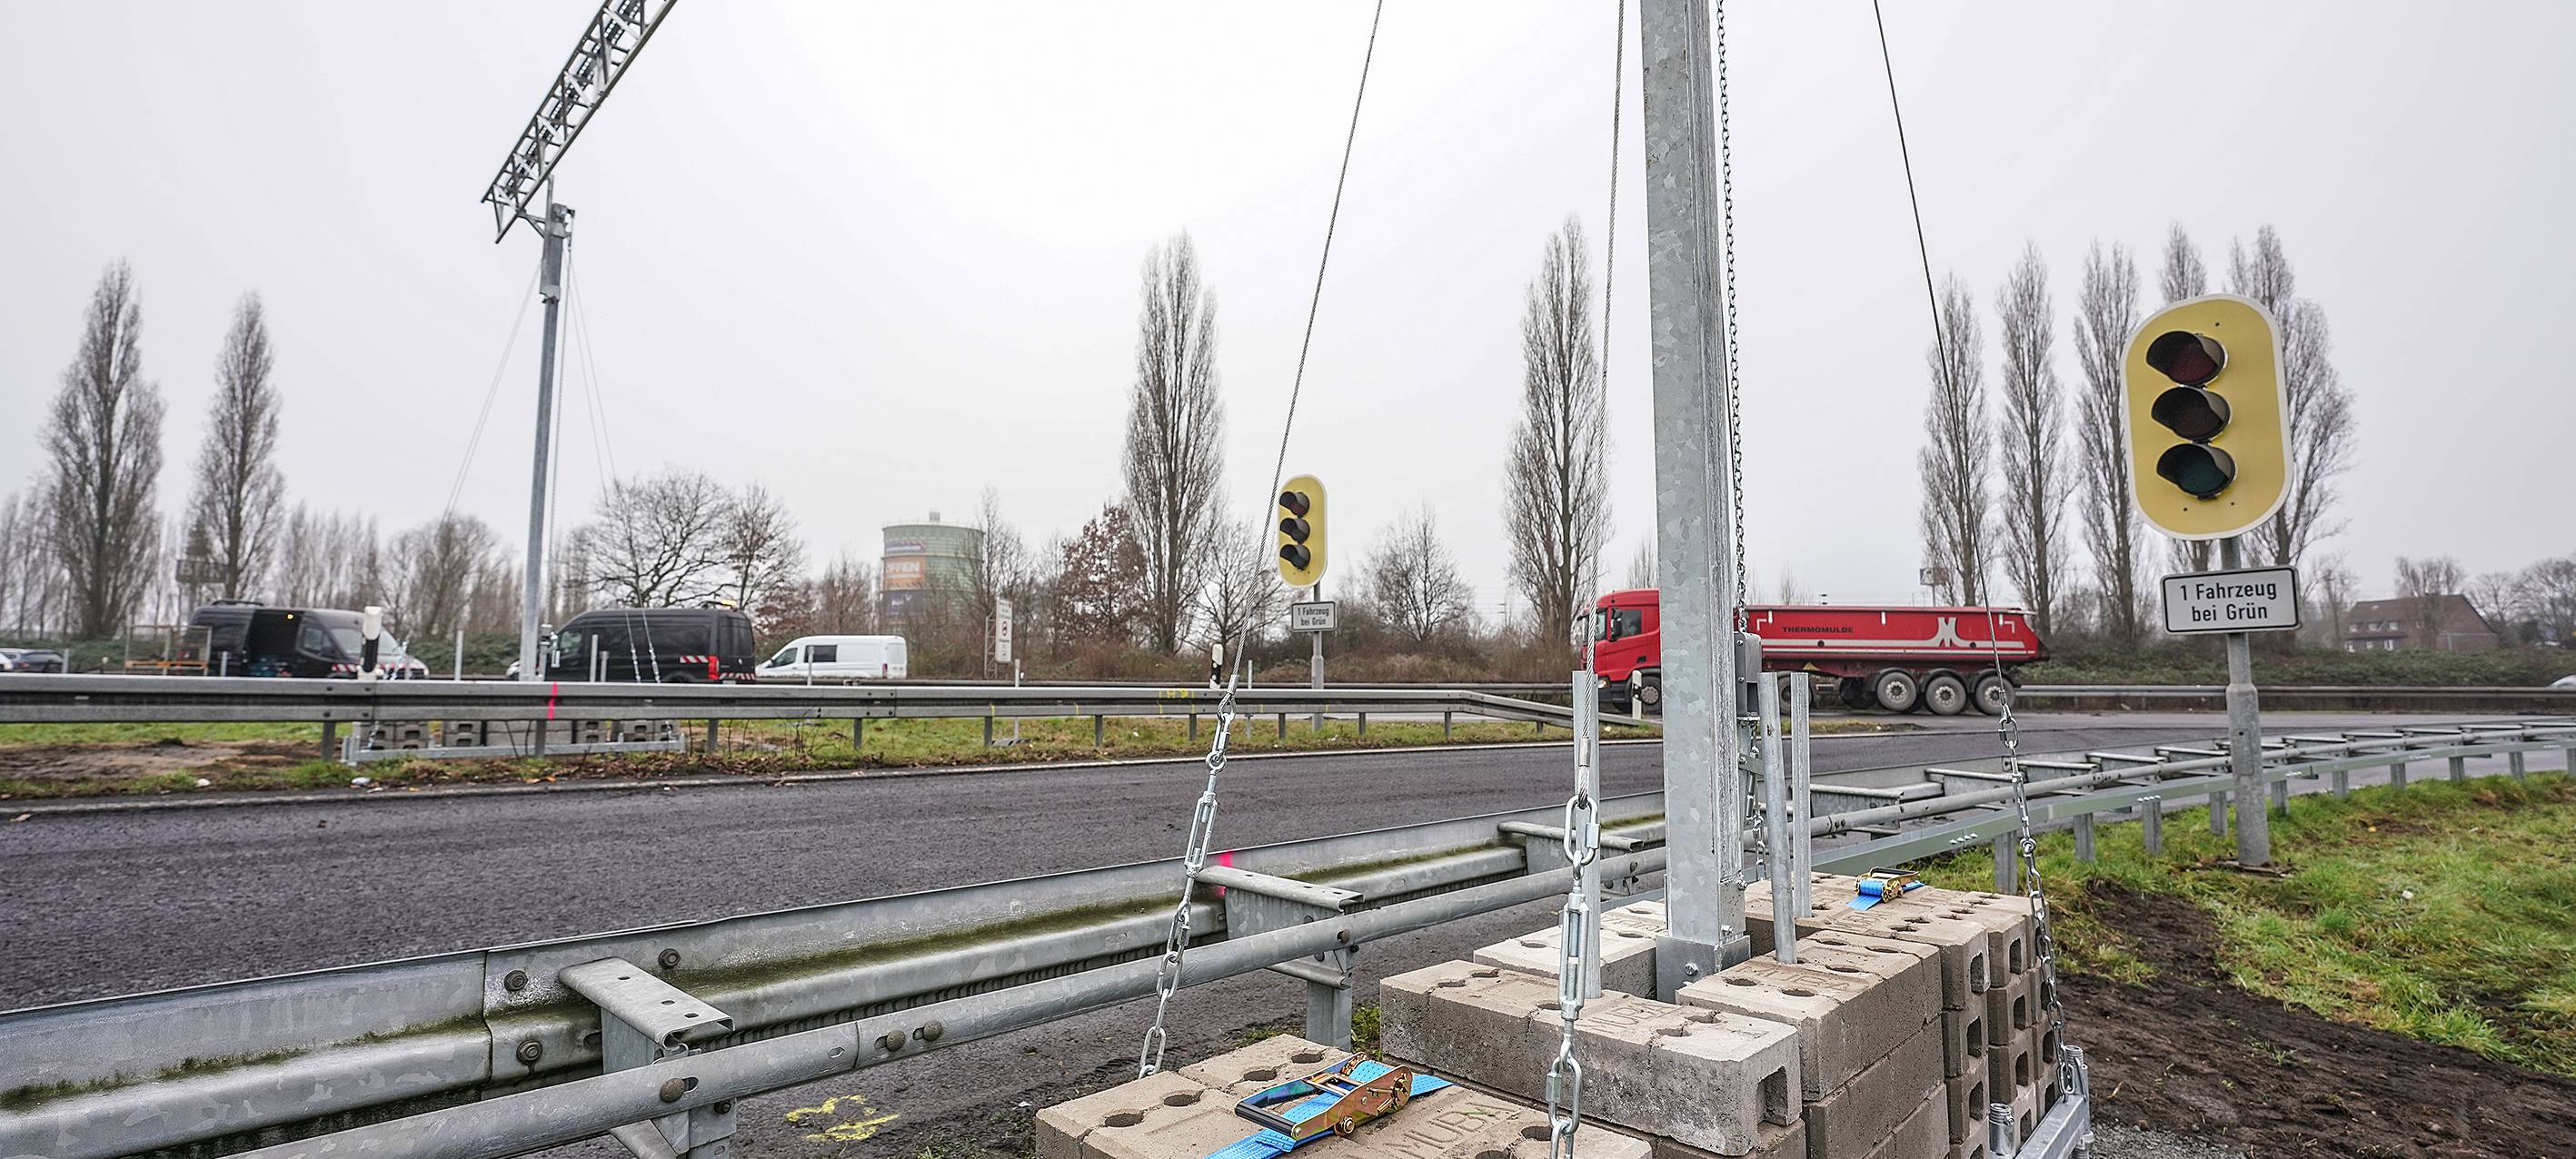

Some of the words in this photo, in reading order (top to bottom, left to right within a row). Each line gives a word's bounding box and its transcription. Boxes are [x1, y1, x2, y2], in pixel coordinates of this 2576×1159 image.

[2180, 585, 2187, 600] 1
[2196, 583, 2277, 599] Fahrzeug
[1302, 607, 1329, 617] Fahrzeug
[2192, 605, 2217, 621] bei
[2226, 602, 2268, 620] Grün
[1301, 618, 1310, 626] bei
[1312, 617, 1326, 626] Grün
